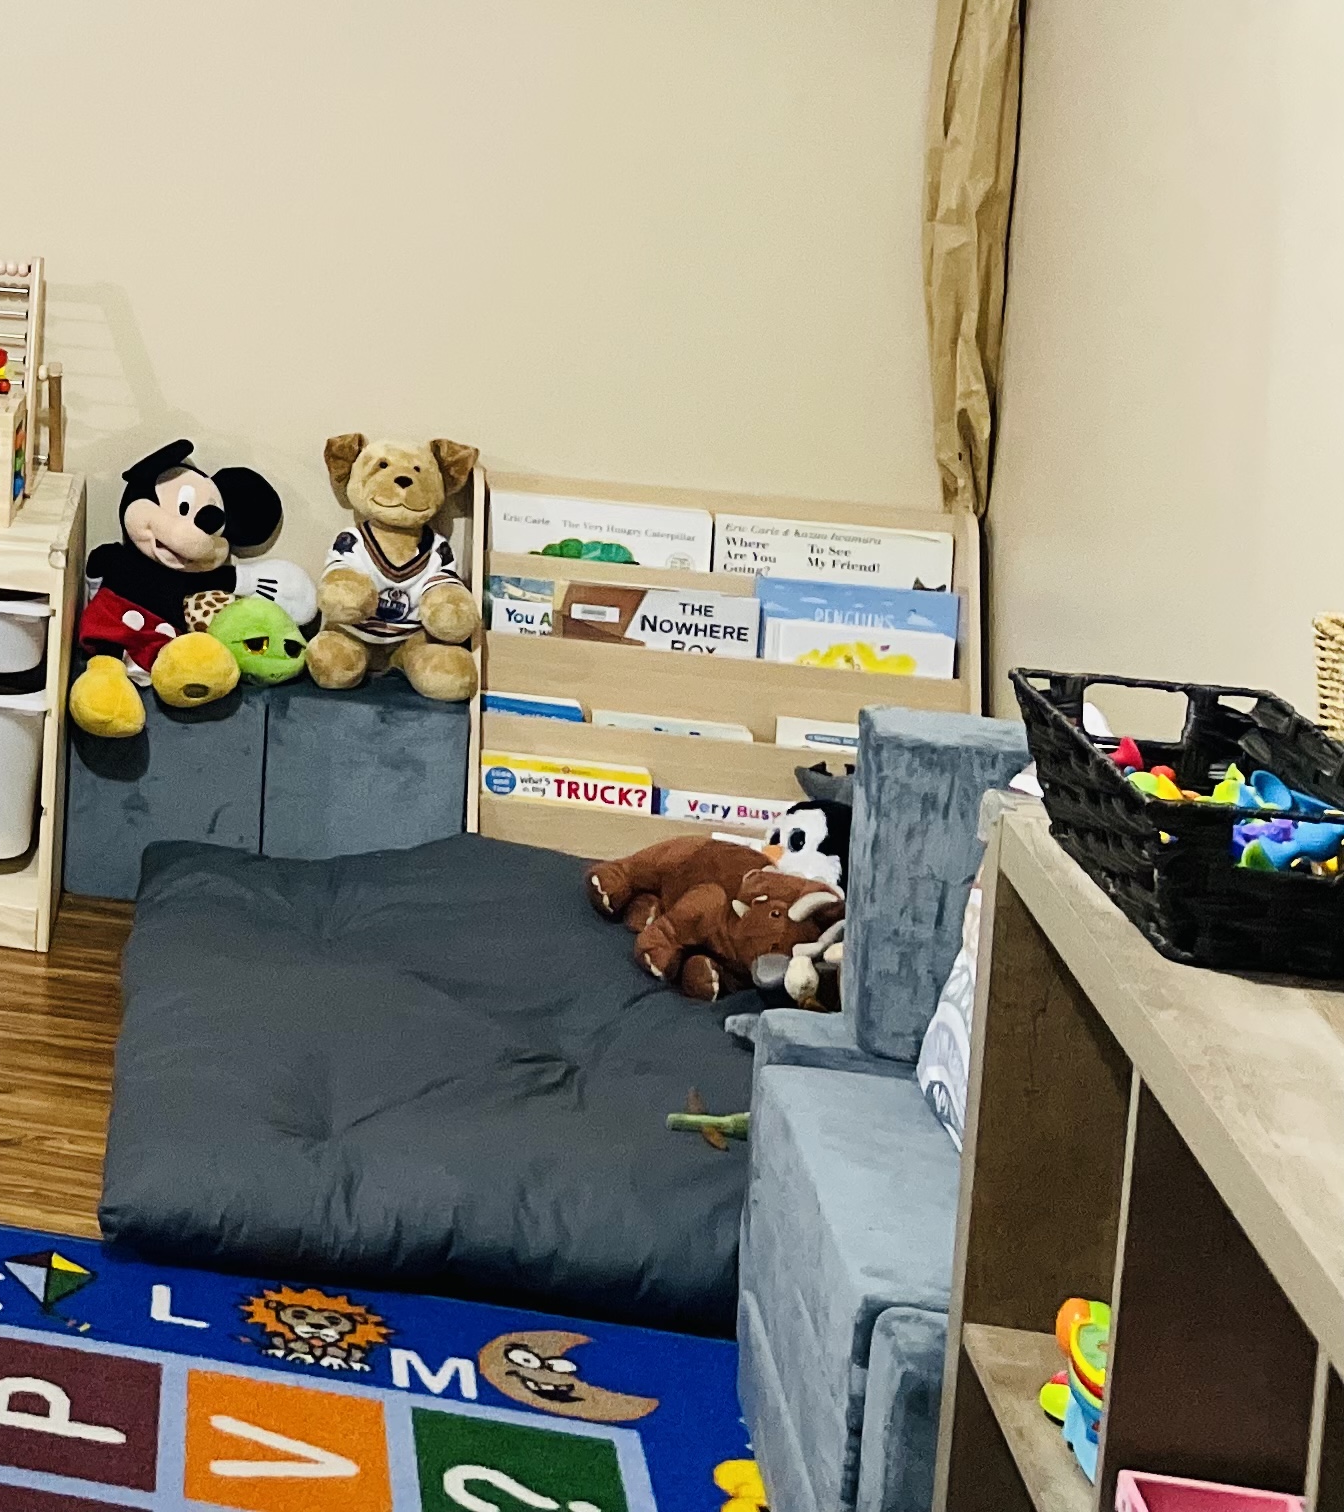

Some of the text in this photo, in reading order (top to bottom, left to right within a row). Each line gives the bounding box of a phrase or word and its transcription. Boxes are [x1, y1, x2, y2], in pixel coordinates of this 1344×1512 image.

[725, 536, 770, 551] Where
[807, 543, 852, 558] To See
[725, 550, 778, 565] Are You
[806, 556, 881, 574] My Friend!
[505, 607, 534, 625] You
[678, 602, 715, 618] THE
[640, 614, 750, 642] NOWHERE
[553, 778, 647, 808] TRUCK?
[687, 799, 732, 819] Very
[736, 804, 783, 824] Busy
[150, 1284, 208, 1328] L
[390, 1347, 478, 1400] M
[209, 1415, 360, 1478] V
